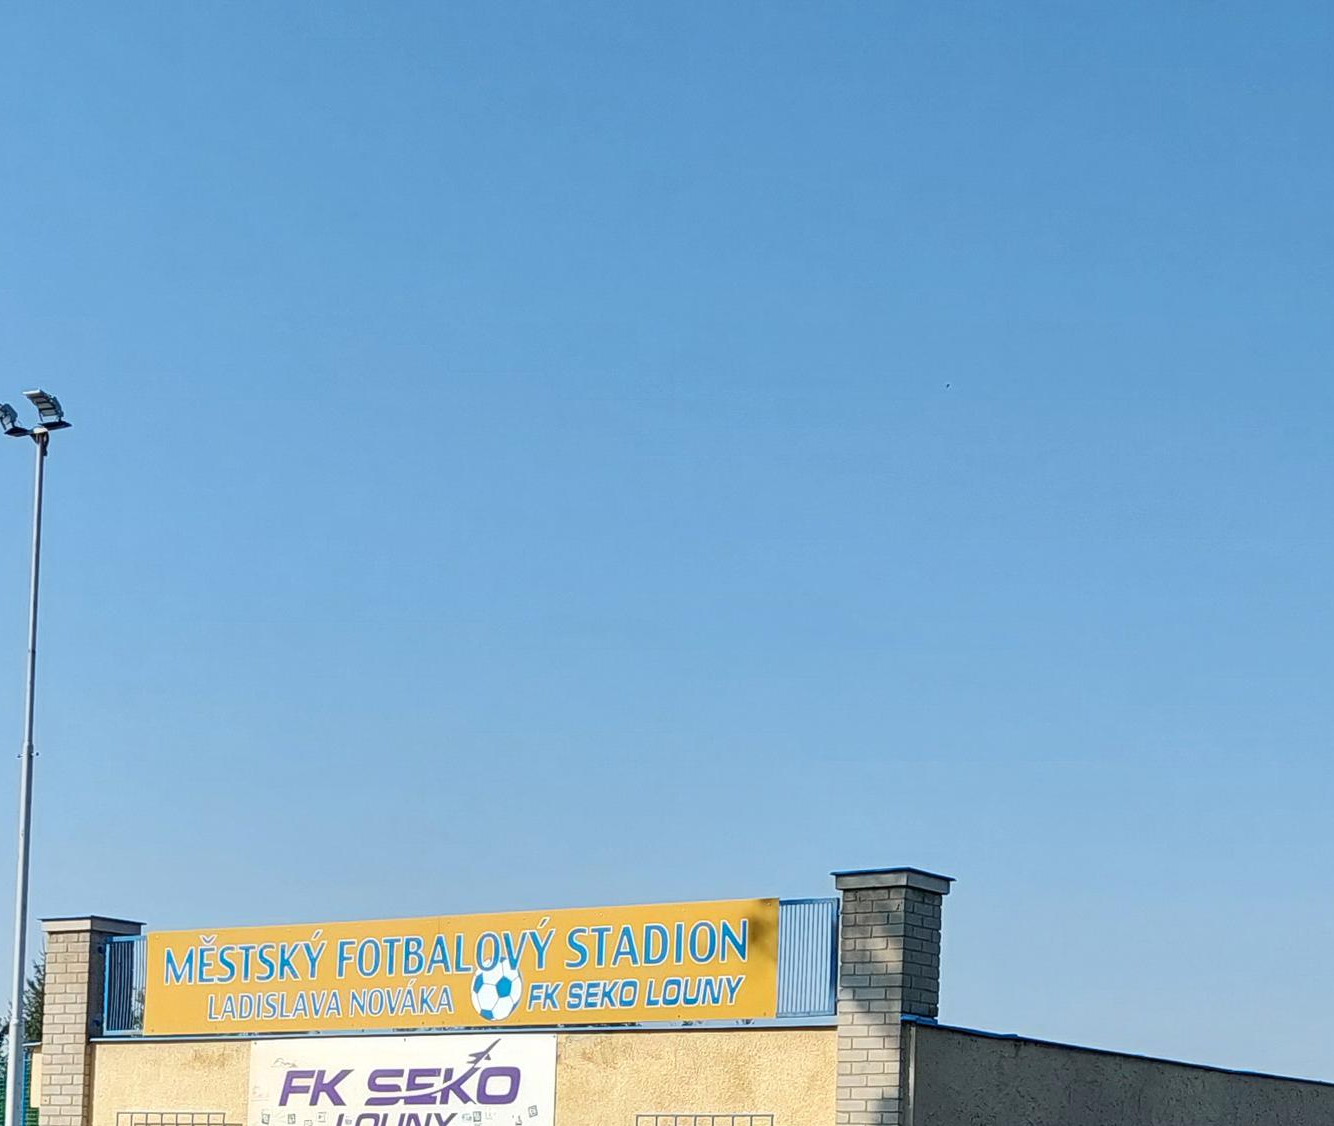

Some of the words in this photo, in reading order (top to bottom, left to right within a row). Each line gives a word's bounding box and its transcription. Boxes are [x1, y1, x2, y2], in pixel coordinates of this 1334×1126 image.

[164, 930, 326, 985] MĚSTSKÝ
[336, 917, 555, 979] FOTBALOVÝ
[564, 918, 749, 970] STADION
[207, 989, 343, 1022] LADISLAVA
[349, 978, 455, 1018] NOVÁKA
[526, 981, 562, 1012] FK
[565, 978, 640, 1011] SEKO
[645, 975, 746, 1007] LOUNY
[278, 1069, 355, 1106] FK
[364, 1066, 521, 1105] SEKO
